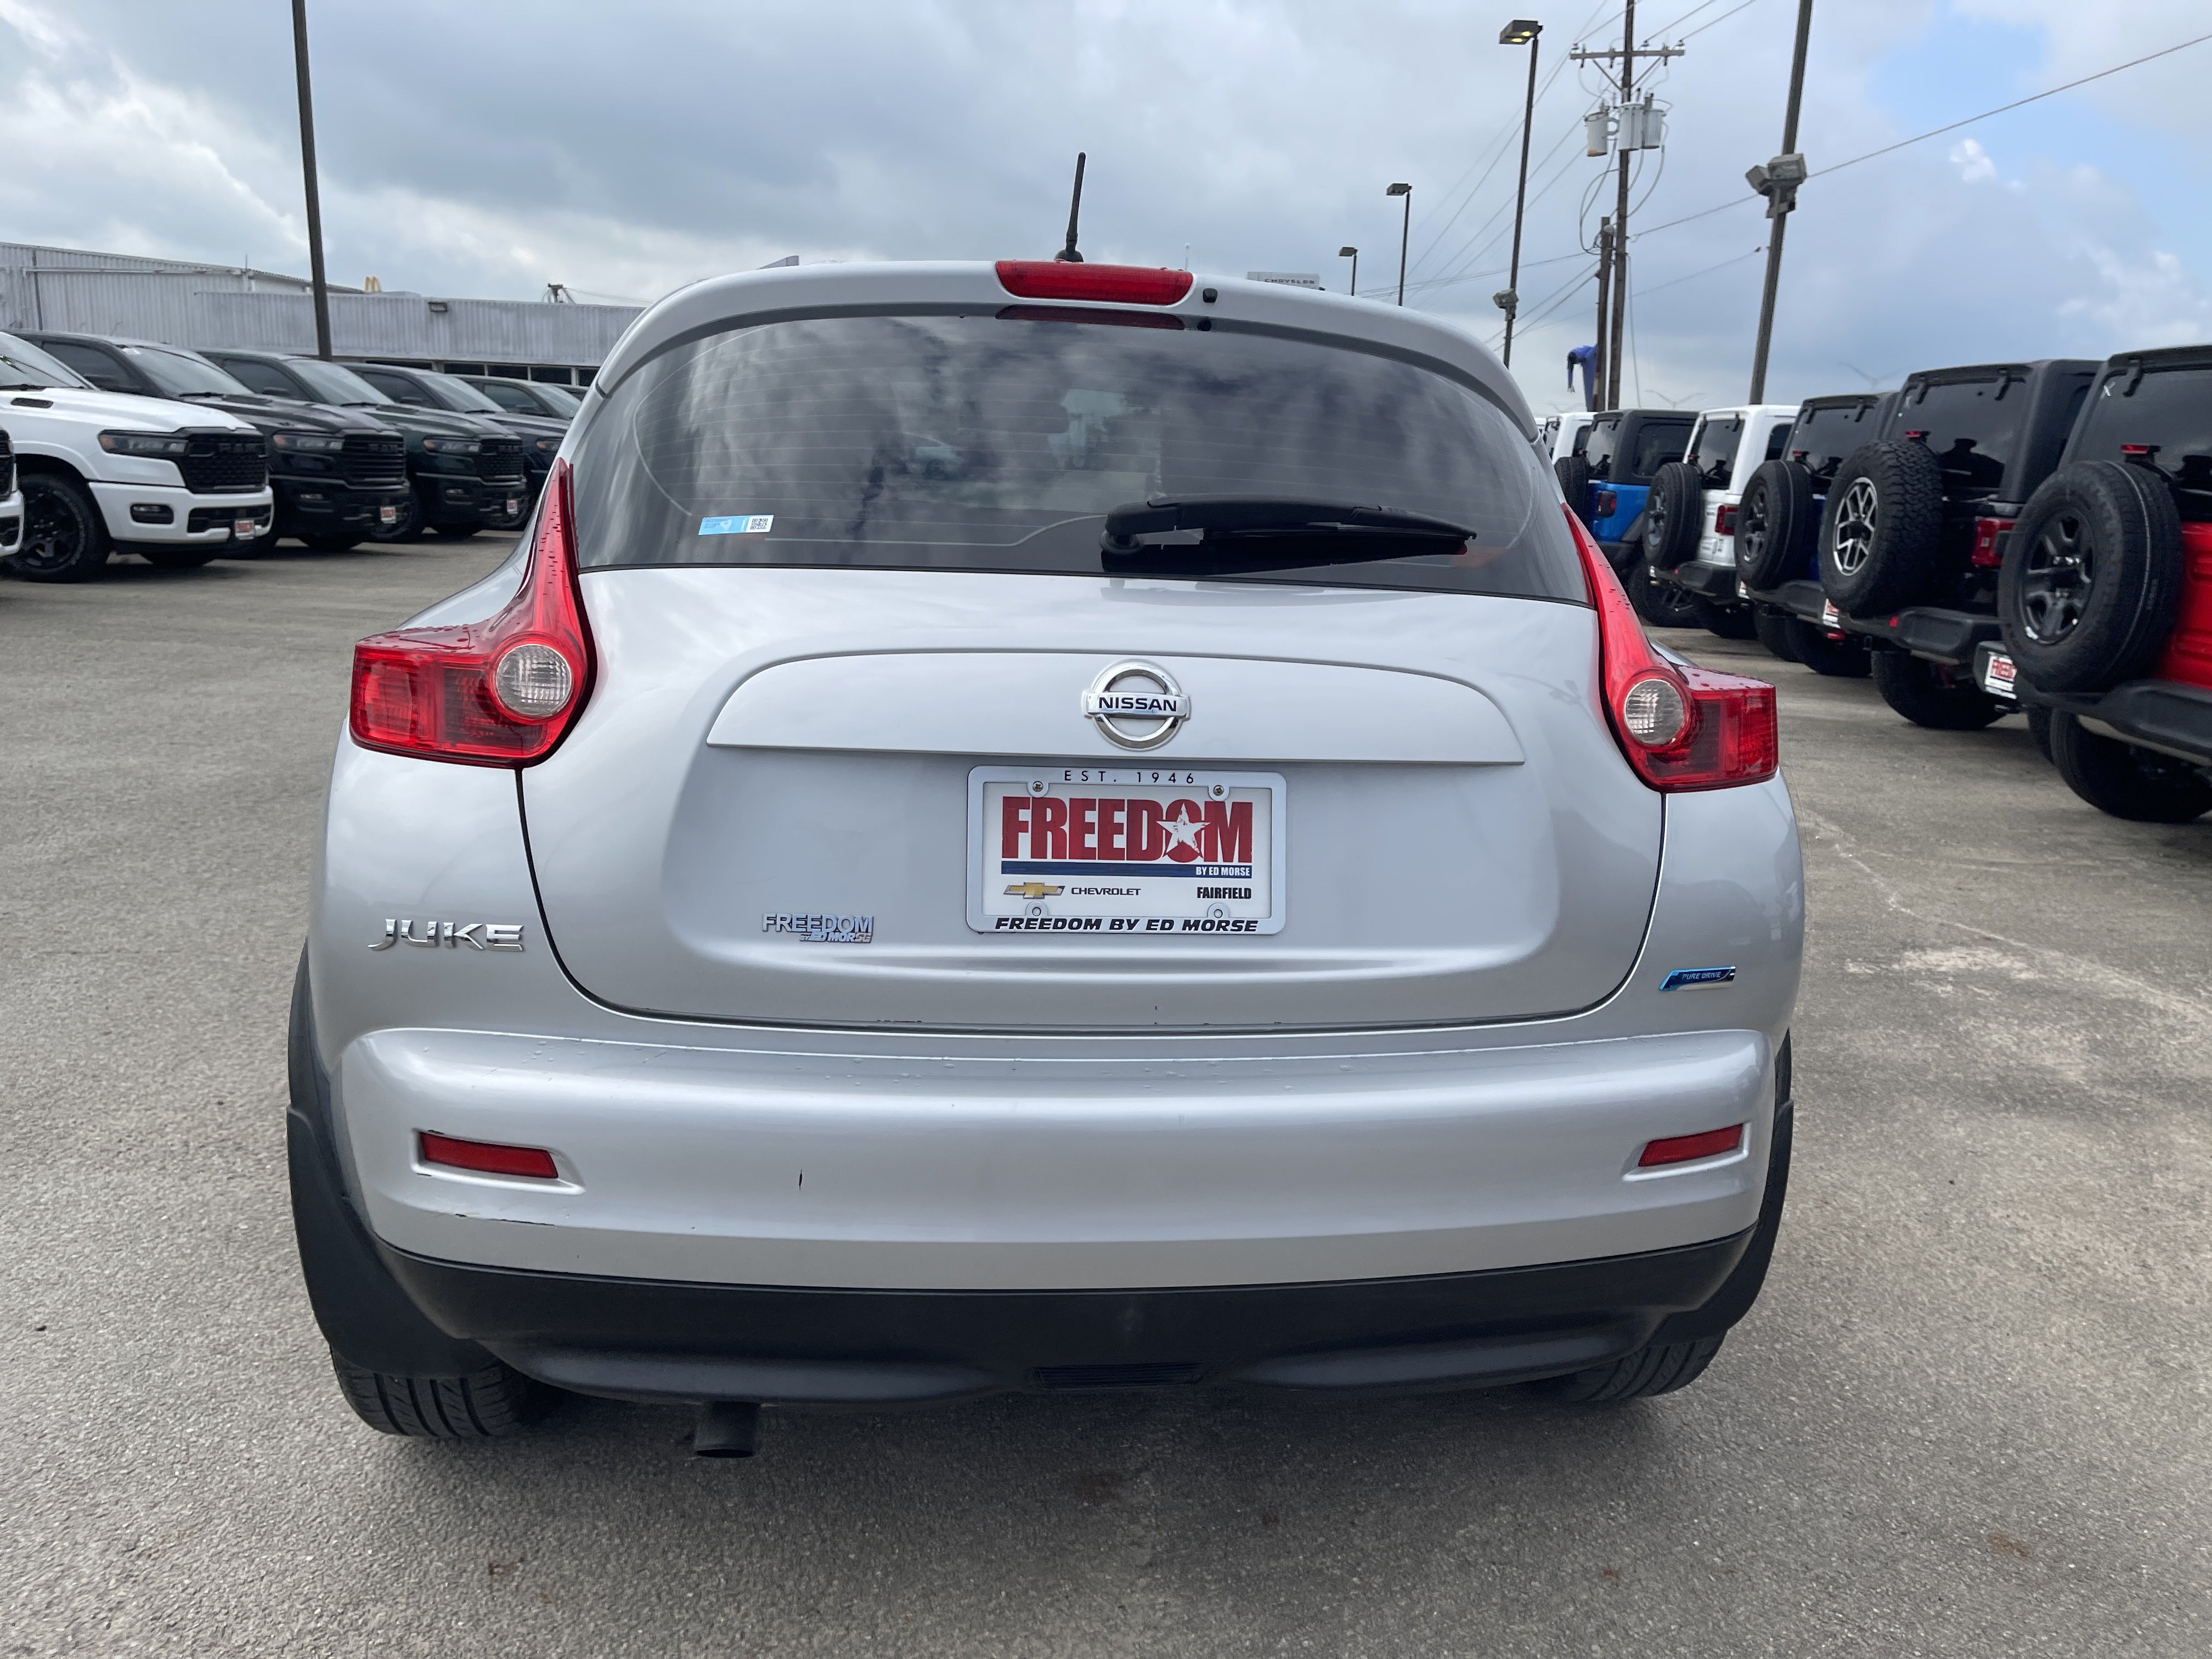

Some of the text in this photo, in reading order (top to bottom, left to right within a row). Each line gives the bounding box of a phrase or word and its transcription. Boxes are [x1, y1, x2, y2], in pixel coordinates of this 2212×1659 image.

[1098, 697, 1177, 712] NISSAN
[1064, 770, 1194, 784] EST. 1946
[1002, 796, 1253, 864] FREEDOM
[1195, 866, 1250, 877] BY ED MORSE
[1071, 887, 1142, 896] CHEVROLET
[1197, 887, 1252, 900] FAIRFIELD
[761, 912, 874, 933] FREEDOM
[995, 917, 1259, 932] FREEDOM BY ED MORSE
[368, 918, 524, 952] JUKE
[809, 932, 827, 942] ED
[827, 932, 872, 943] MORSE
